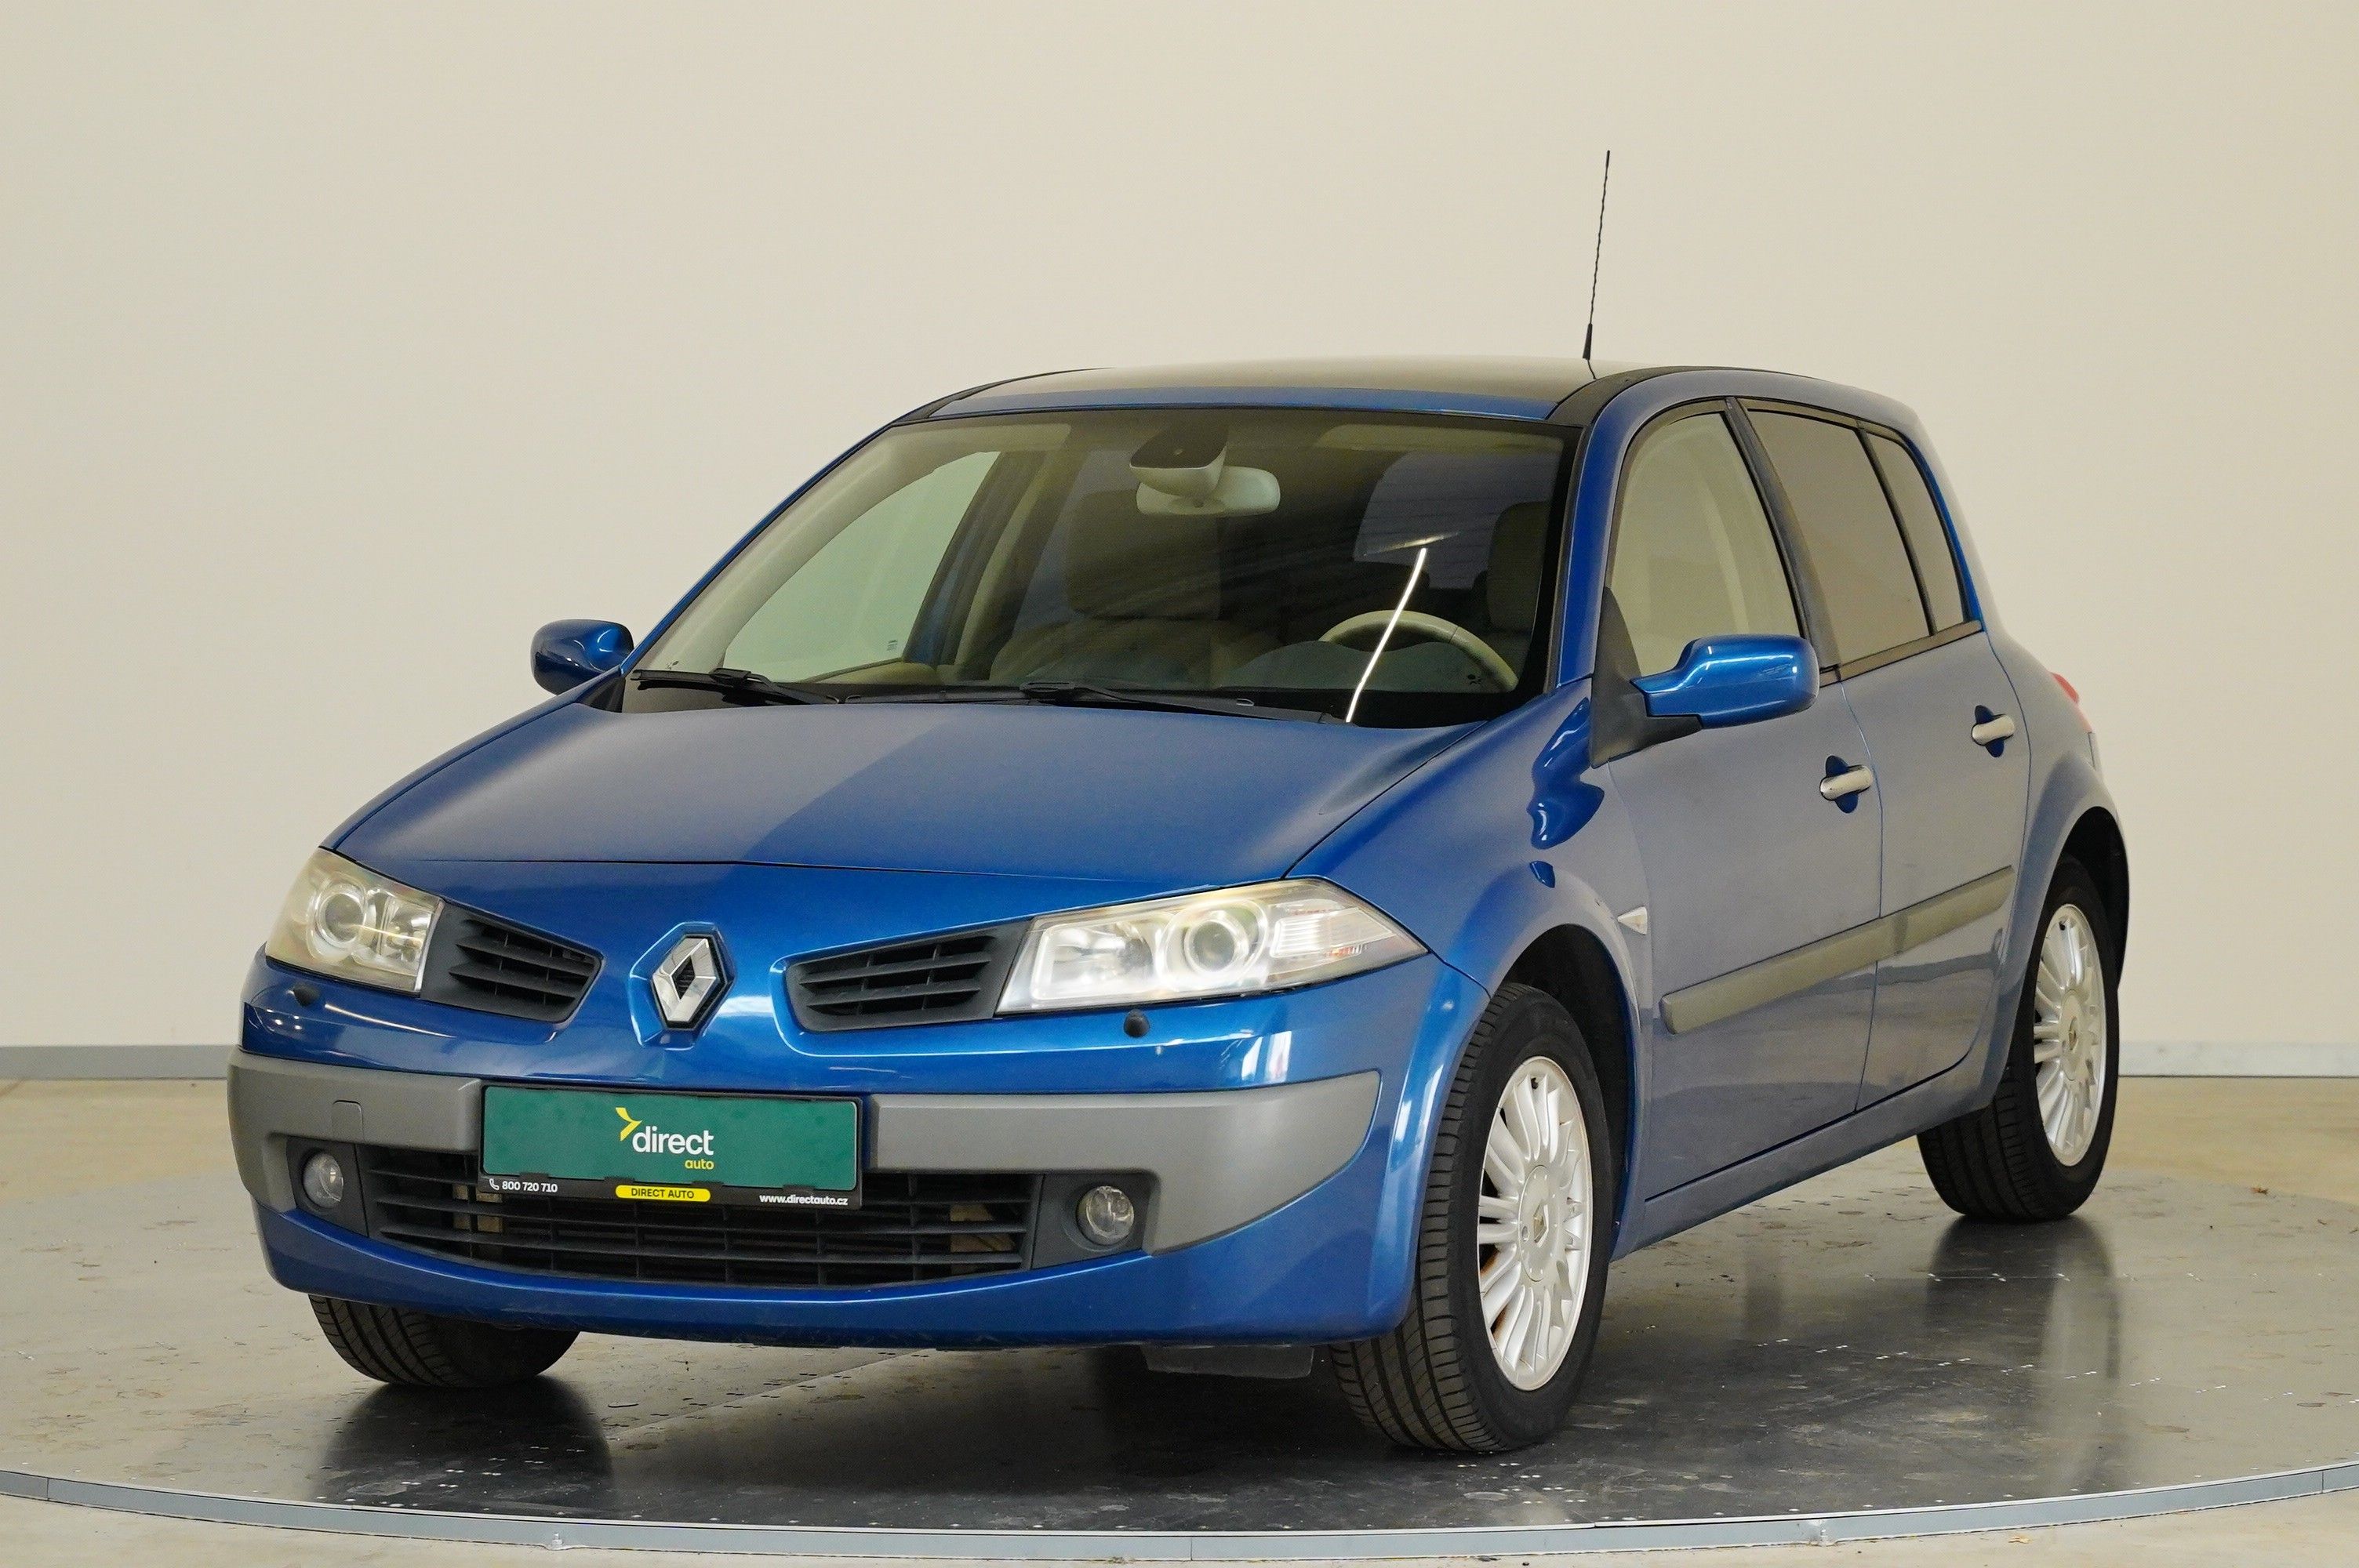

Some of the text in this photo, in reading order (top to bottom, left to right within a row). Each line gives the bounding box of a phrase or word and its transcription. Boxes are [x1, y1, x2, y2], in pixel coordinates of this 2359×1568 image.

[632, 1125, 714, 1156] direct
[685, 1159, 714, 1170] auto
[502, 1181, 558, 1192] 800 720 710
[631, 1188, 694, 1199] DIRECT AUTO
[759, 1194, 849, 1206] www.directauto.cz
